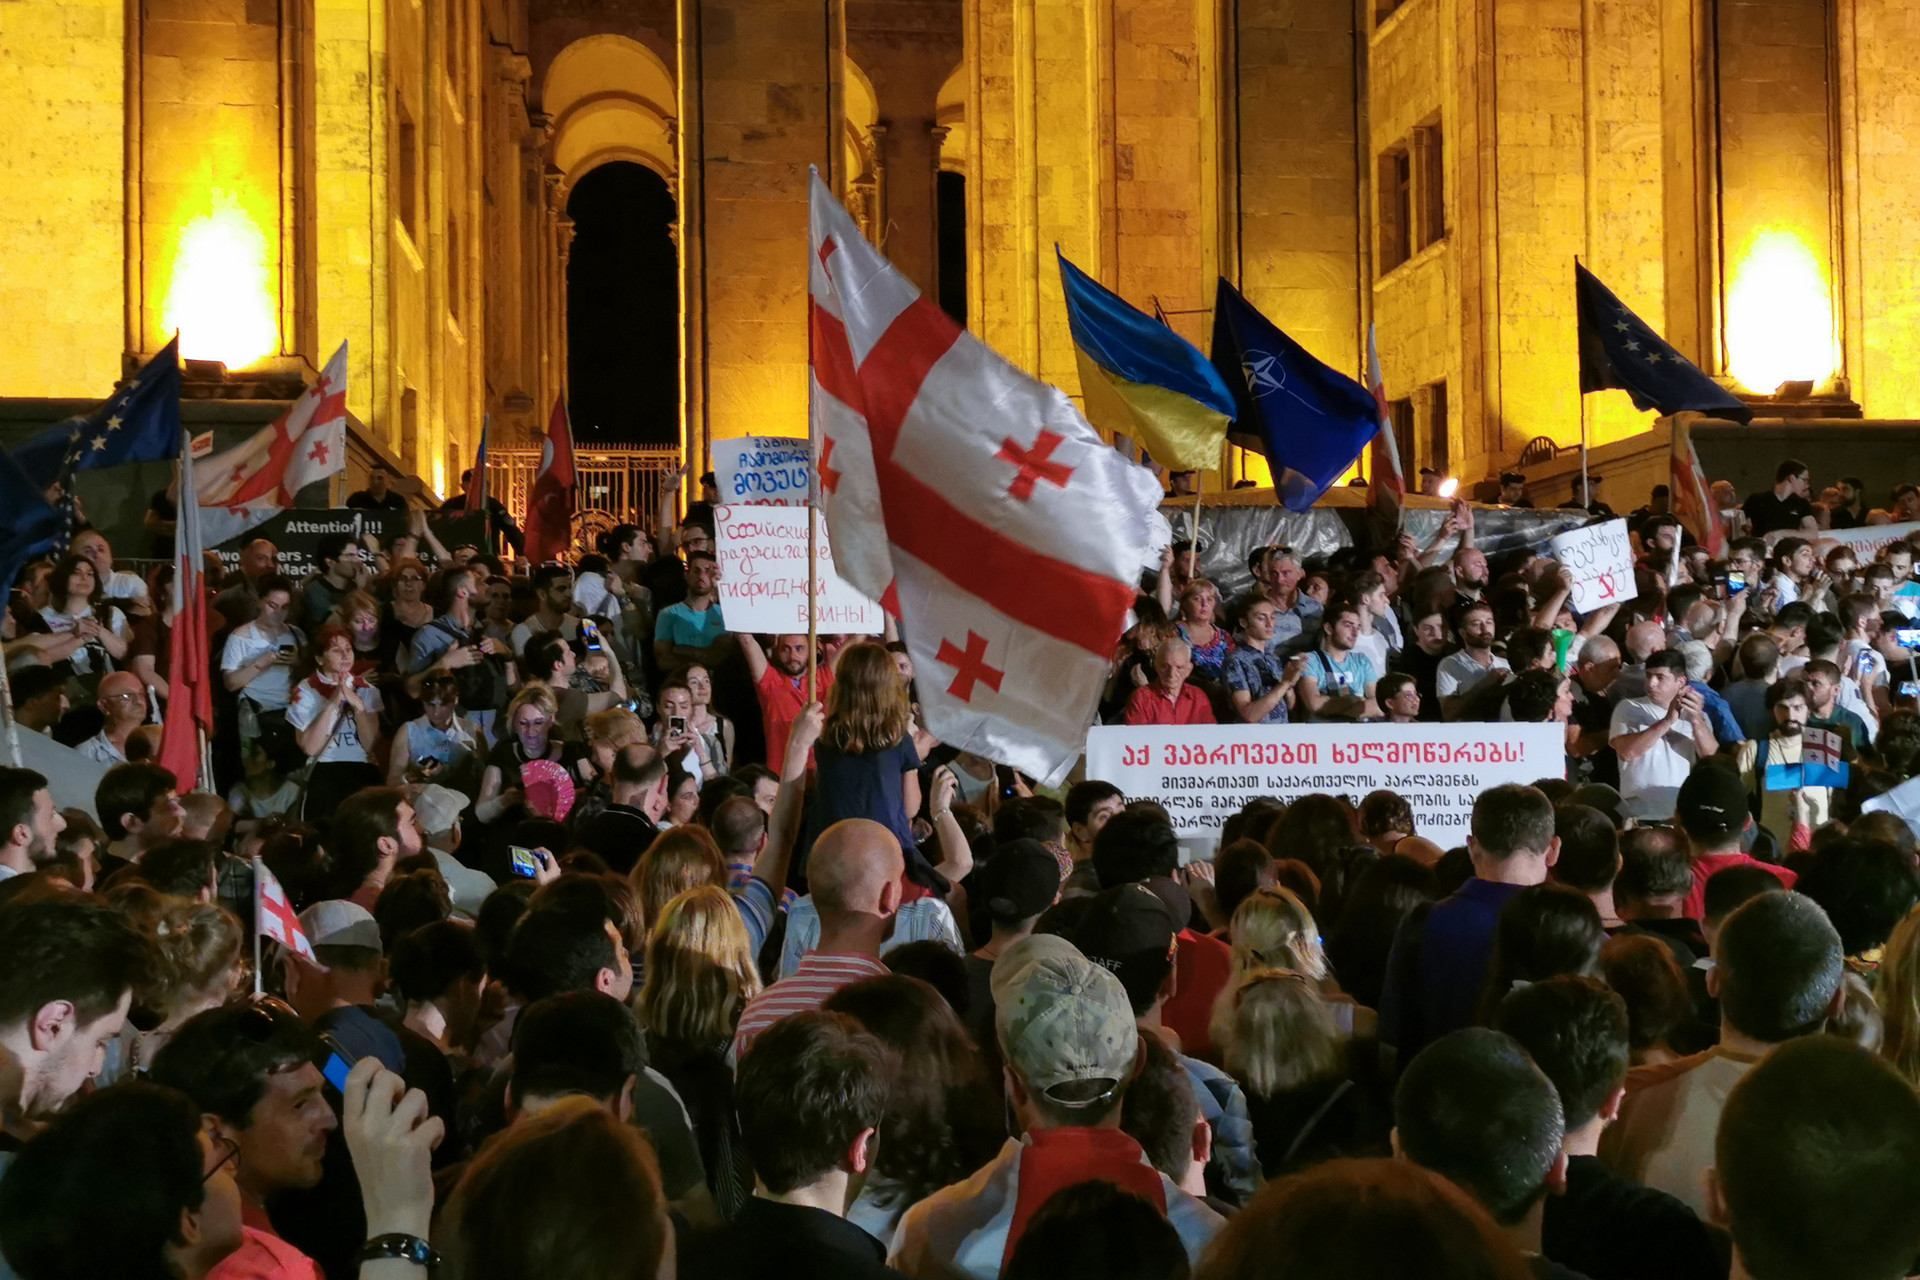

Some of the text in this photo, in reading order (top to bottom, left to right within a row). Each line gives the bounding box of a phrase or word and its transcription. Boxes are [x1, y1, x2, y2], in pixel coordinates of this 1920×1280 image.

[1122, 741, 1525, 766] აქ ვაგროვებთ ხელმოწერებს!
[1161, 774, 1479, 790] მივმართავთ საქართველოს პარლამენტს
